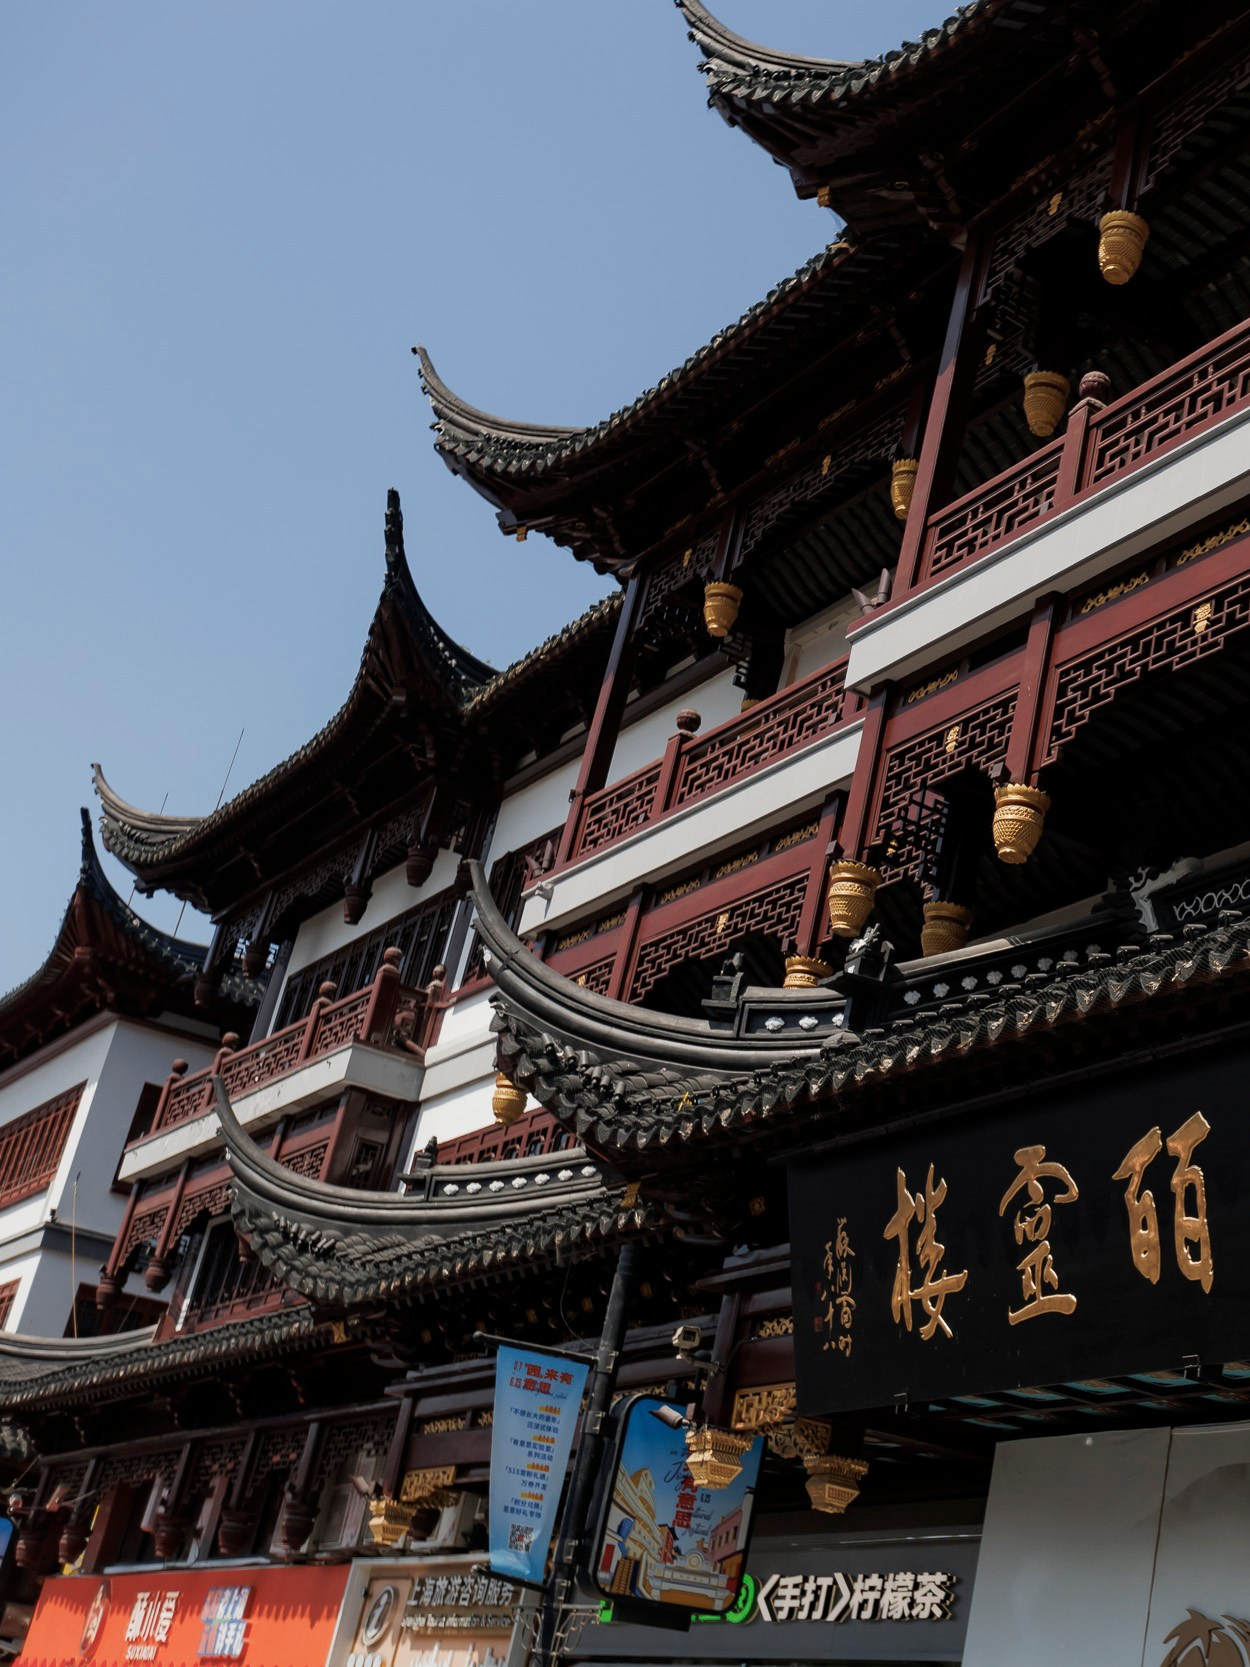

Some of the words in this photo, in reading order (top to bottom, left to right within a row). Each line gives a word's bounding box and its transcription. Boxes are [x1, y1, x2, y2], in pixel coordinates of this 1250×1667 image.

[522, 1377, 552, 1395] 意思
[406, 1575, 516, 1606] 上海旅游咨询服务
